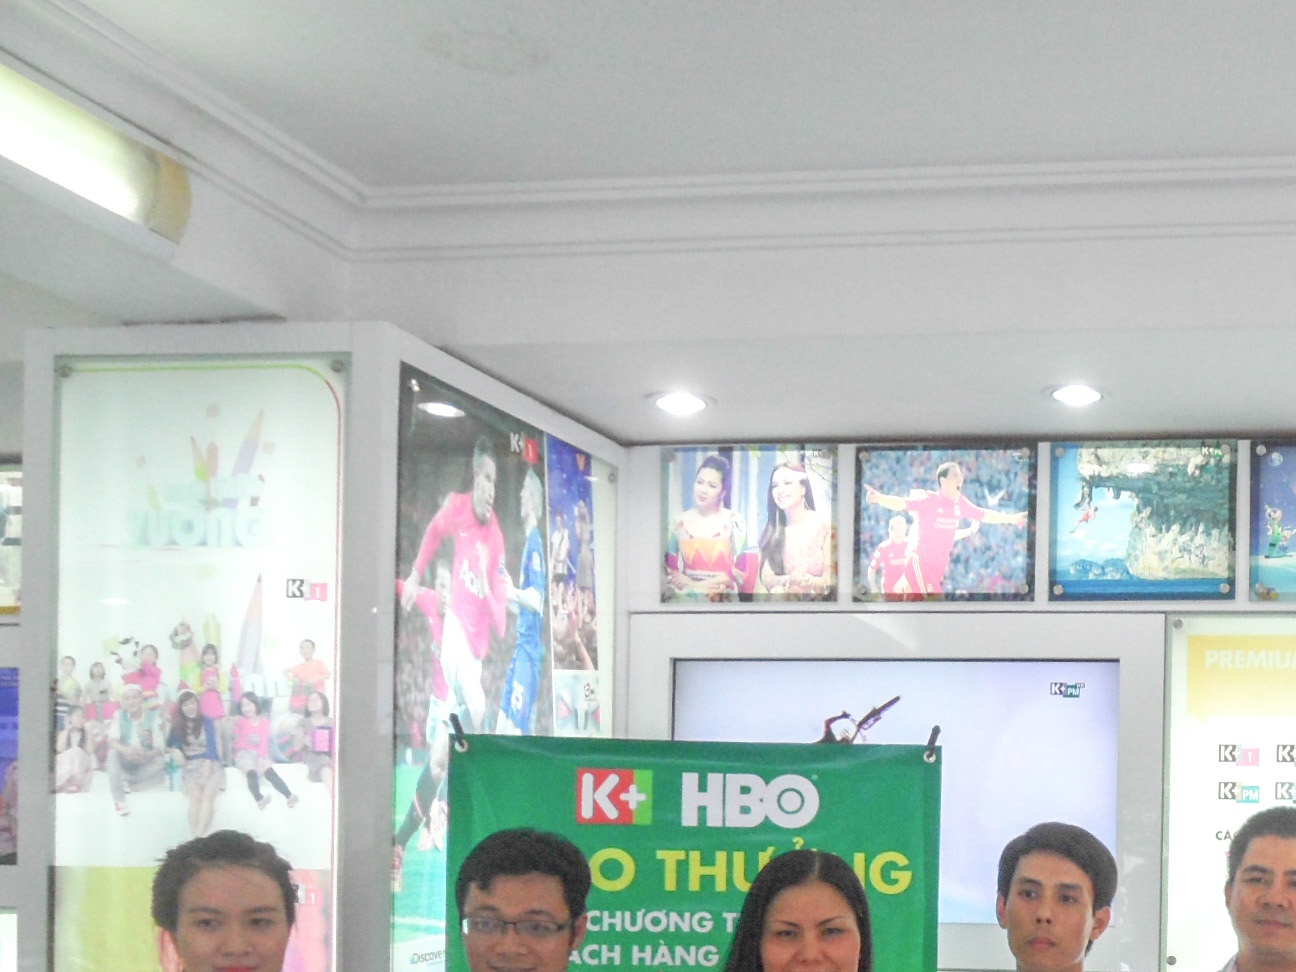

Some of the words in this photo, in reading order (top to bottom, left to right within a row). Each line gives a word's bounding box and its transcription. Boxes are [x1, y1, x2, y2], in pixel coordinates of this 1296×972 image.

[580, 771, 647, 820] K+
[681, 772, 819, 829] HBO
[586, 908, 715, 933] CHƯƠNG
[632, 939, 720, 967] HÀNG
